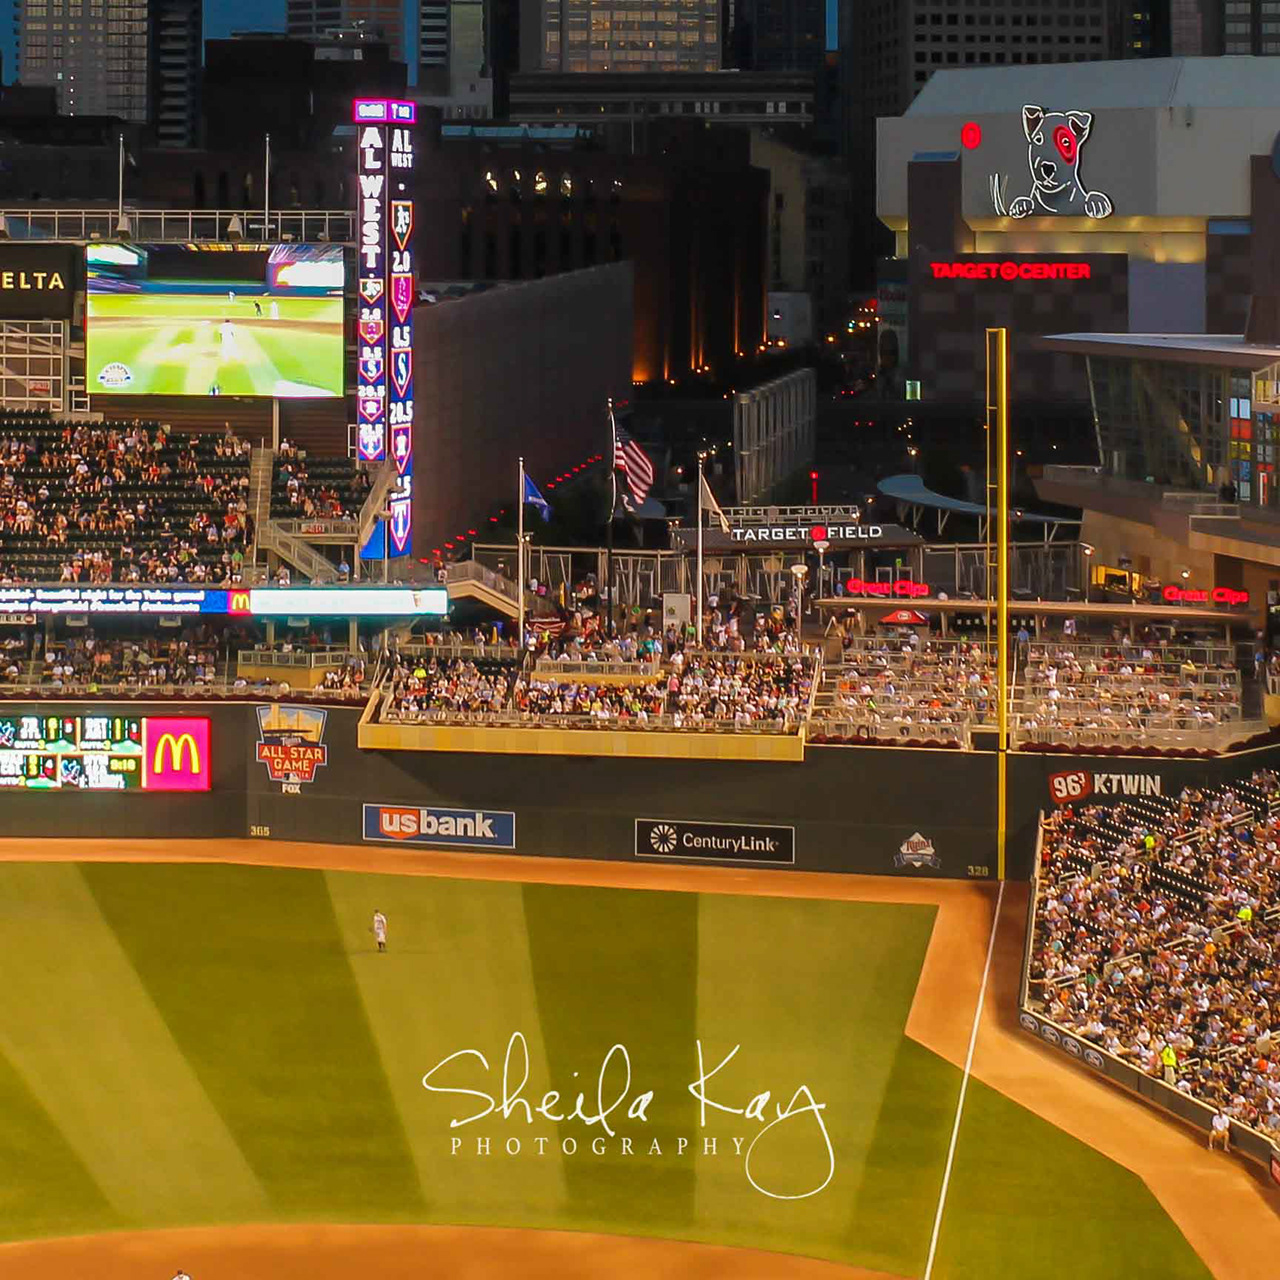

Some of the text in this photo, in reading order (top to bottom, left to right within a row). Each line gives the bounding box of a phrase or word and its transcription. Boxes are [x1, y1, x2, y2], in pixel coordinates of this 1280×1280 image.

[392, 128, 412, 152] AL
[930, 262, 1091, 280] TARGET CENTER
[733, 526, 882, 541] TARGET FIELD
[262, 746, 323, 759] ALL STAR
[274, 759, 310, 771] GAME
[282, 783, 301, 794] FOX
[683, 832, 776, 853] CenturyLink
